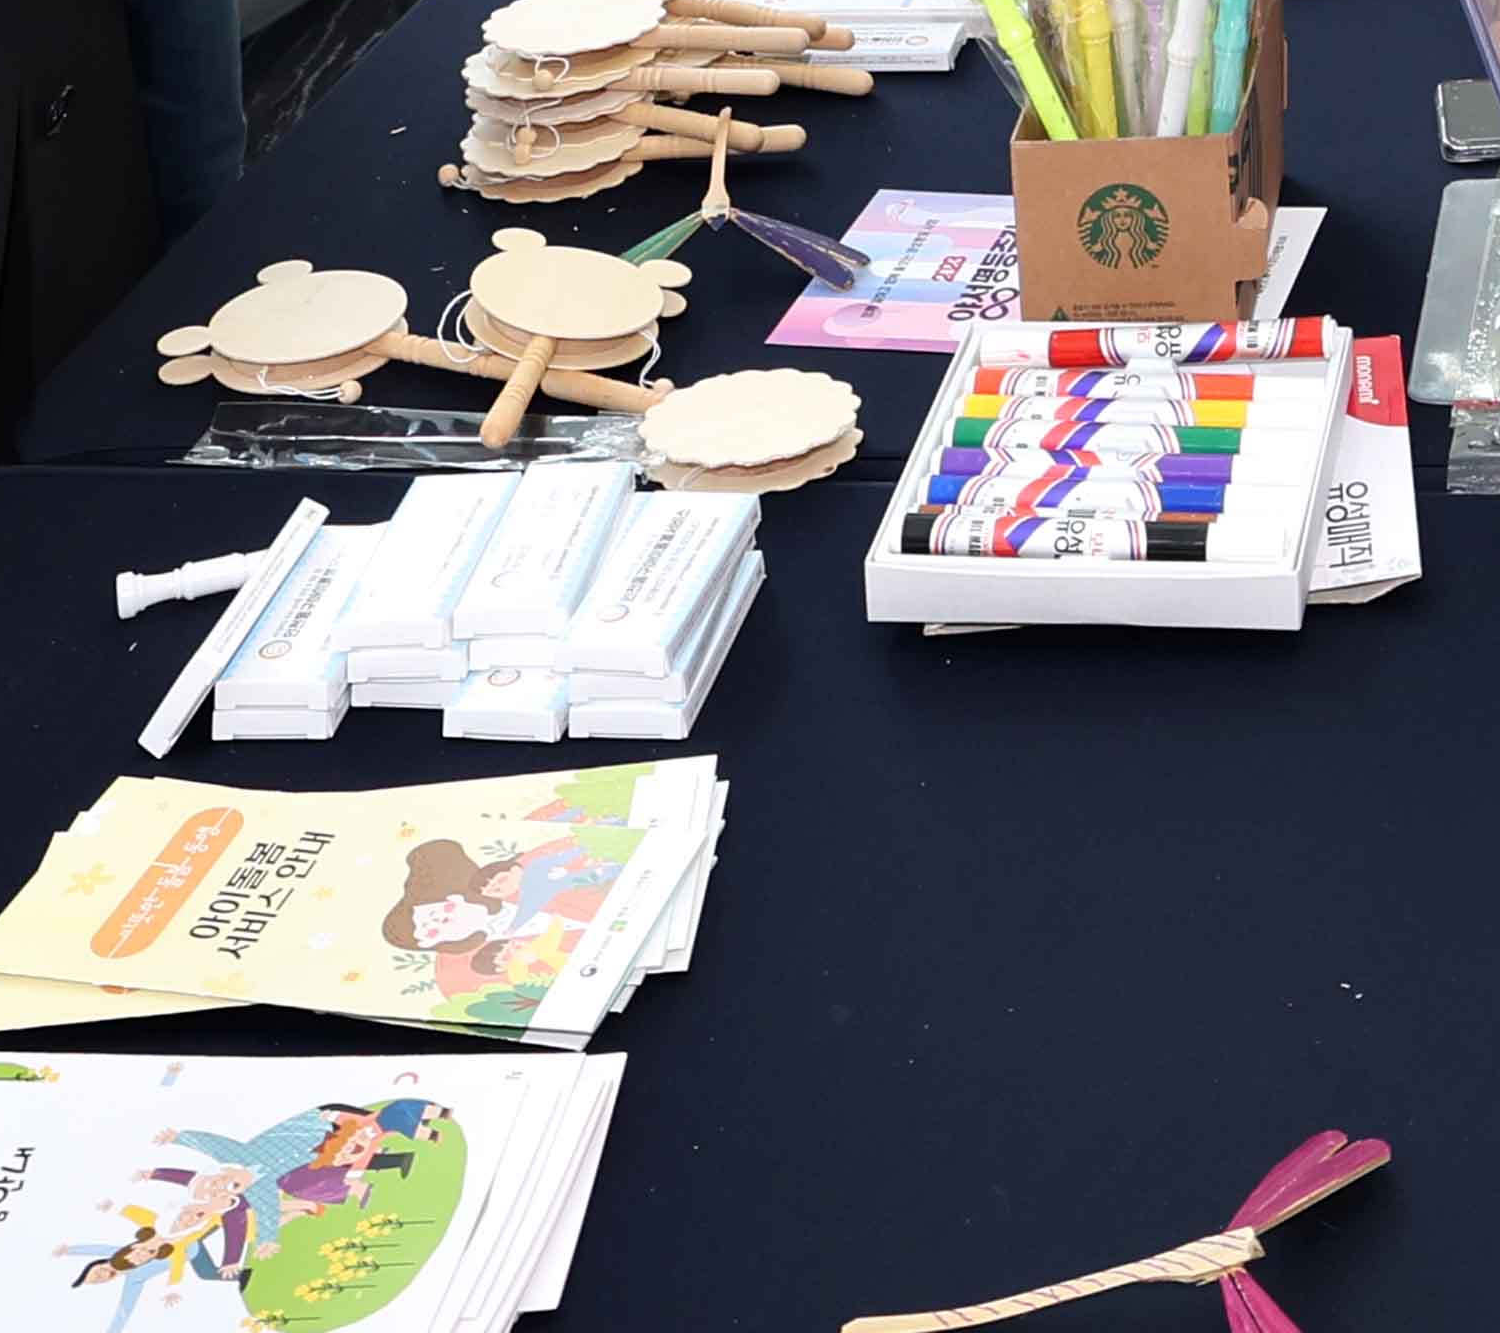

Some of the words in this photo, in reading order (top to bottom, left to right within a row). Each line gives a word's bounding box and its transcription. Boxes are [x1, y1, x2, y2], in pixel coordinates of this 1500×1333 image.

[1326, 482, 1374, 569] 유성매직
[188, 842, 287, 939] 아이돌봄
[217, 887, 295, 960] 서비스
[275, 831, 336, 879] 안내
